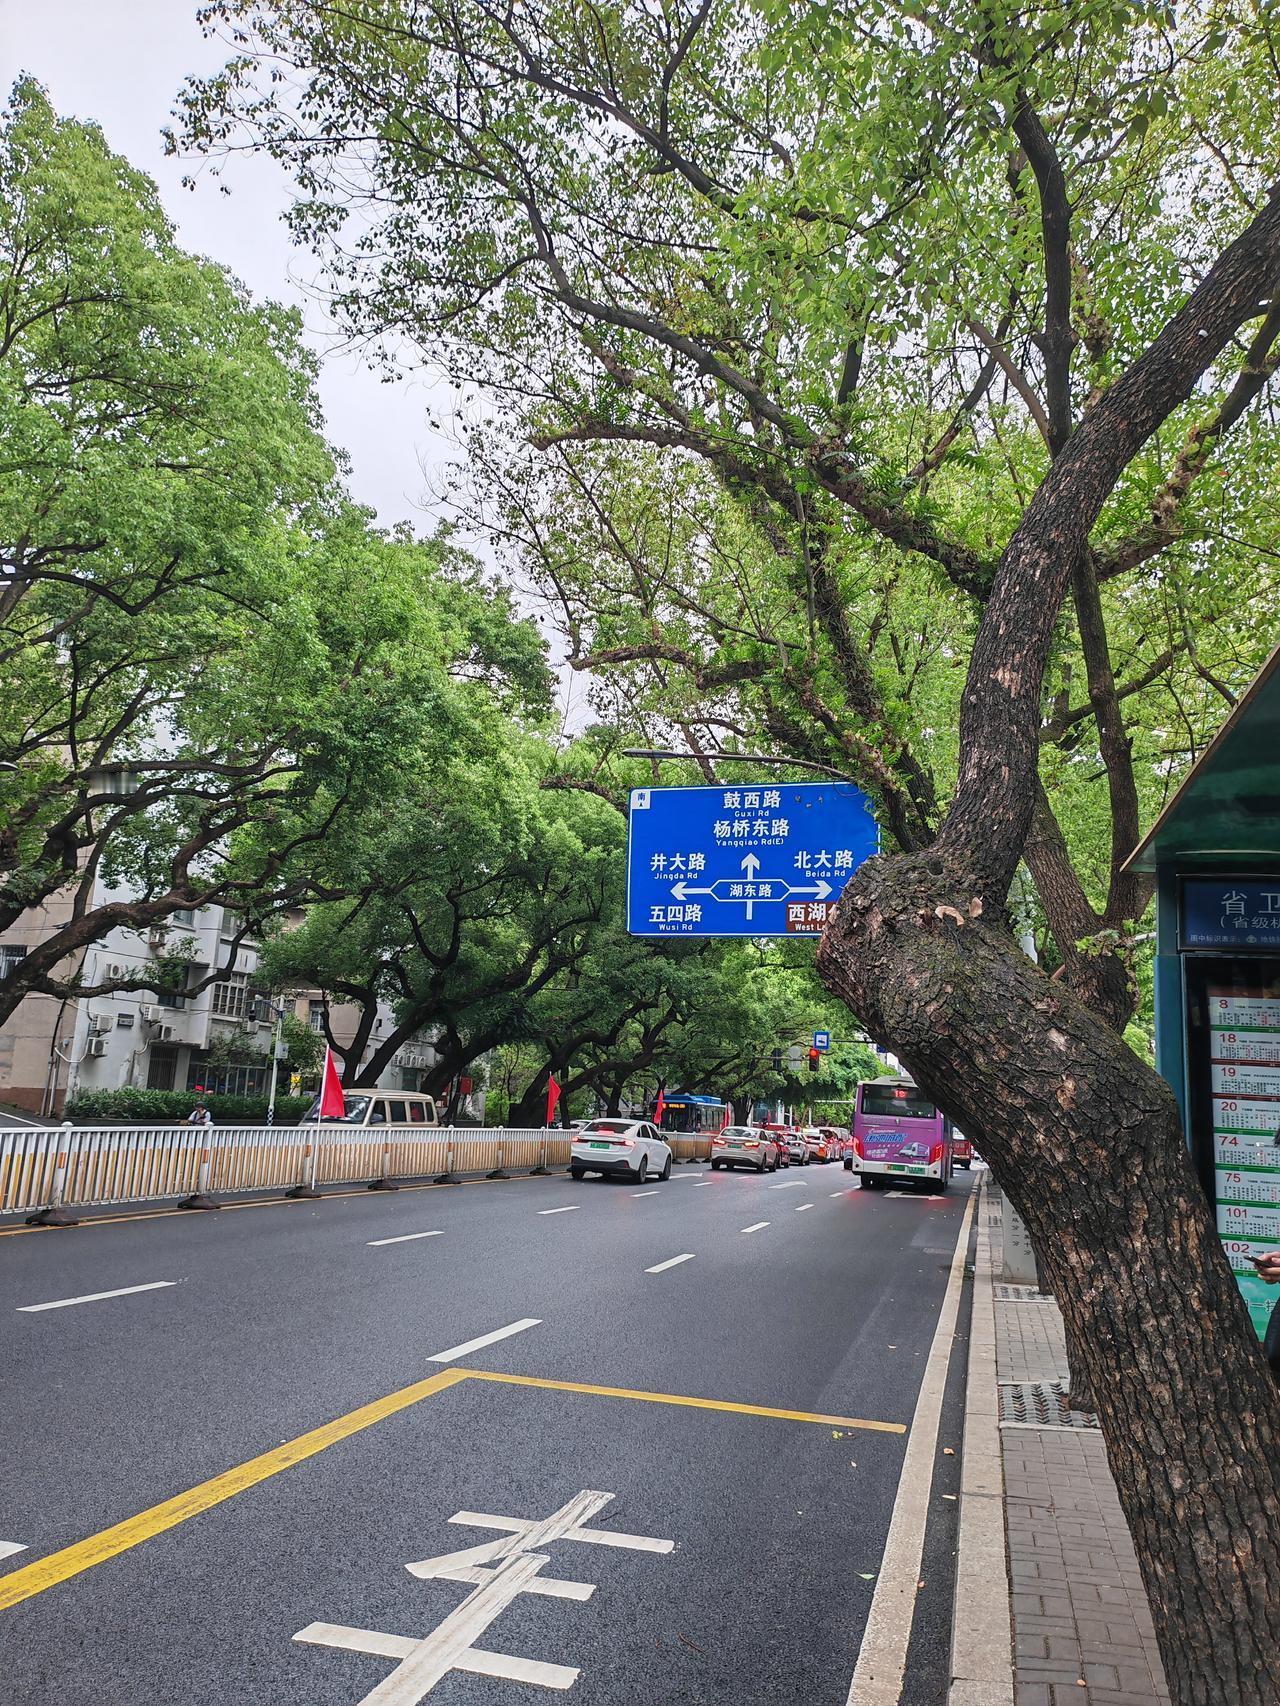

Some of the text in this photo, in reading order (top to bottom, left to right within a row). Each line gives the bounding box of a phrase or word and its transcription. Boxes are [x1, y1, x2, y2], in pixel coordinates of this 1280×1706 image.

[637, 792, 646, 802] 南
[723, 790, 781, 809] 鼓西路
[734, 809, 770, 818] Guxi Rd
[713, 818, 790, 838] 杨桥东路
[716, 838, 784, 848] Yangqiao Rd(E)
[650, 852, 706, 871] 井大路
[793, 850, 854, 869] 北大路
[654, 873, 685, 881] Jingda
[805, 869, 846, 878] Beida Rd
[729, 884, 772, 898] 湖东路
[648, 904, 702, 923] 五四路
[795, 923, 815, 931] West
[1219, 999, 1229, 1009] 8
[1219, 1033, 1237, 1043] 18
[1221, 1067, 1236, 1077] 19
[1221, 1101, 1238, 1112] 20
[1219, 1135, 1239, 1147] 74
[1225, 1172, 1241, 1183] 75
[1226, 1207, 1248, 1219] 101
[1223, 1242, 1250, 1254] 102
